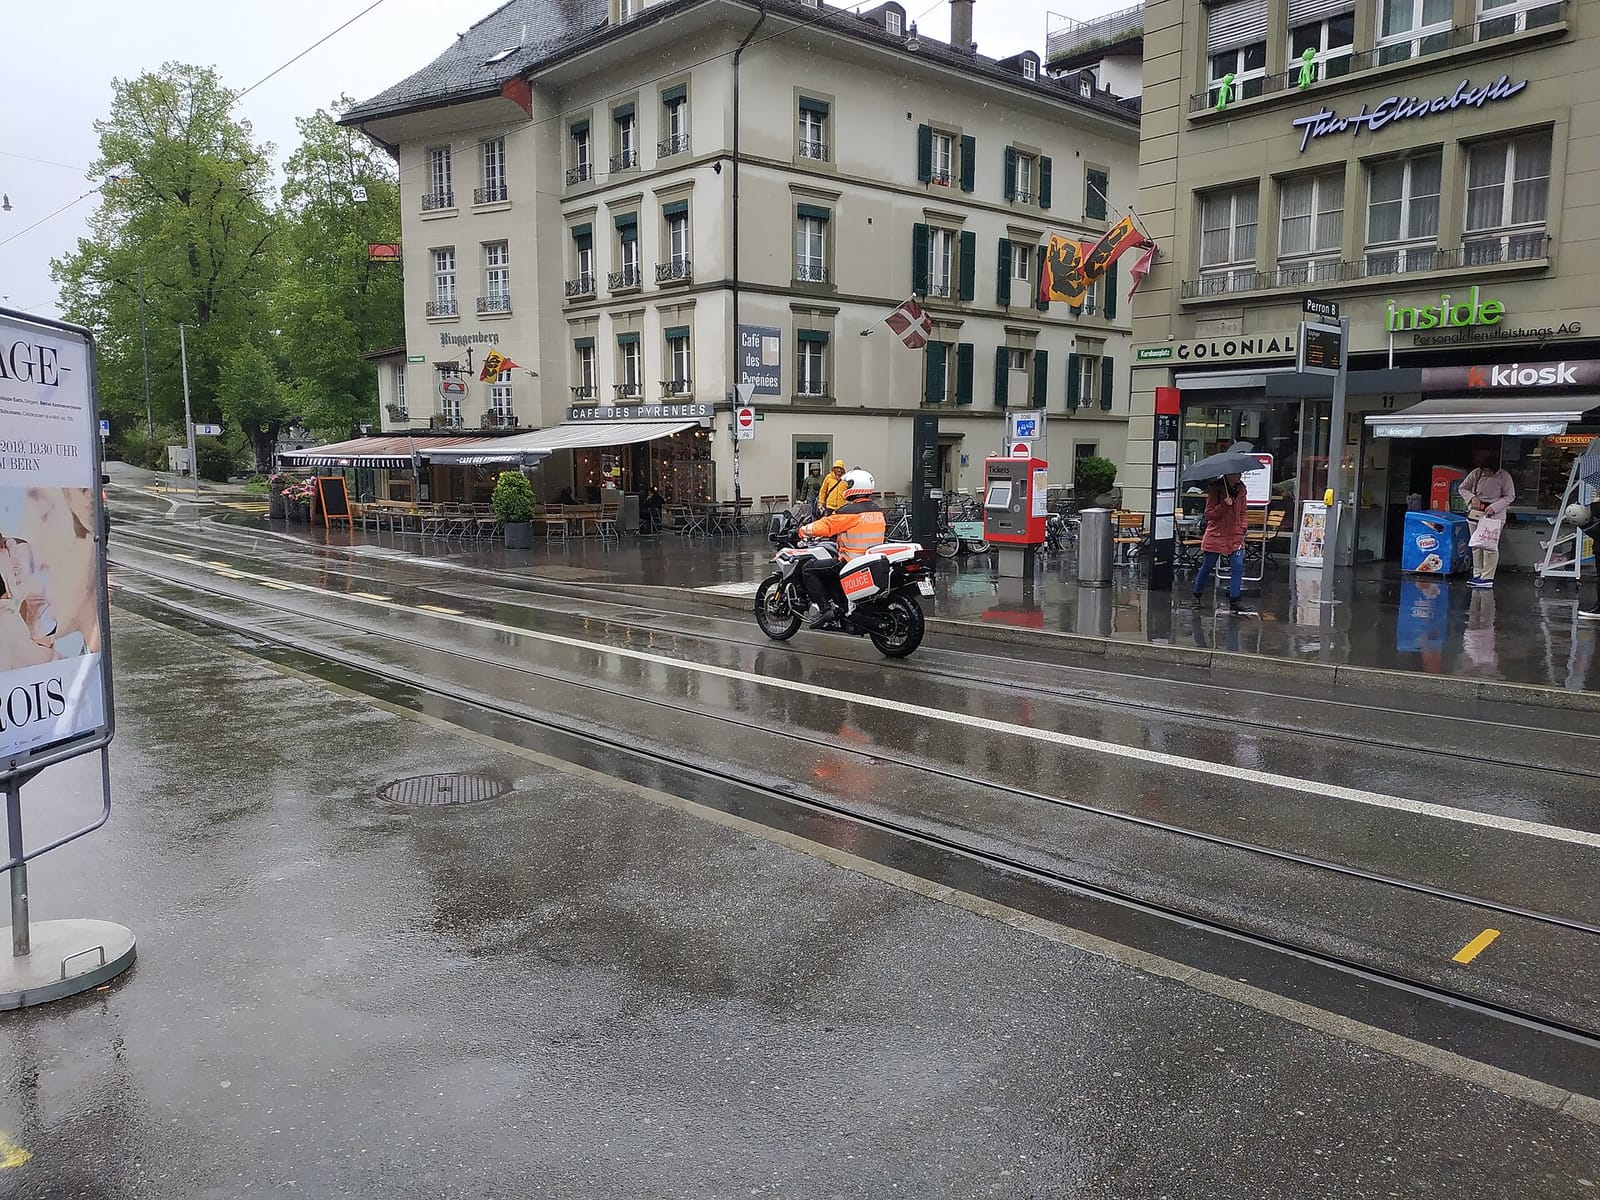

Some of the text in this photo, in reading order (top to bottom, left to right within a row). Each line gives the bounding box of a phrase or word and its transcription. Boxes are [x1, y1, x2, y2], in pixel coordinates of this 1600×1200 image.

[1307, 299, 1336, 315] Perron B
[1386, 286, 1506, 332] inside
[440, 331, 500, 347] Ringgenberg
[742, 332, 760, 348] Café
[1413, 321, 1582, 346] Personaldienstleistungs AG
[1177, 336, 1295, 360] COLONIAL
[745, 353, 760, 367] des
[1491, 362, 1578, 387] kiosk
[1382, 396, 1394, 408] 11
[572, 405, 706, 419] CAFE DES PYRENEES
[1555, 436, 1590, 444] SWISSLO
[56, 443, 78, 457] UHR
[10, 457, 41, 471] BERN
[989, 465, 1010, 474] Tickets
[844, 574, 869, 590] POLICE
[0, 676, 66, 732] OIS
